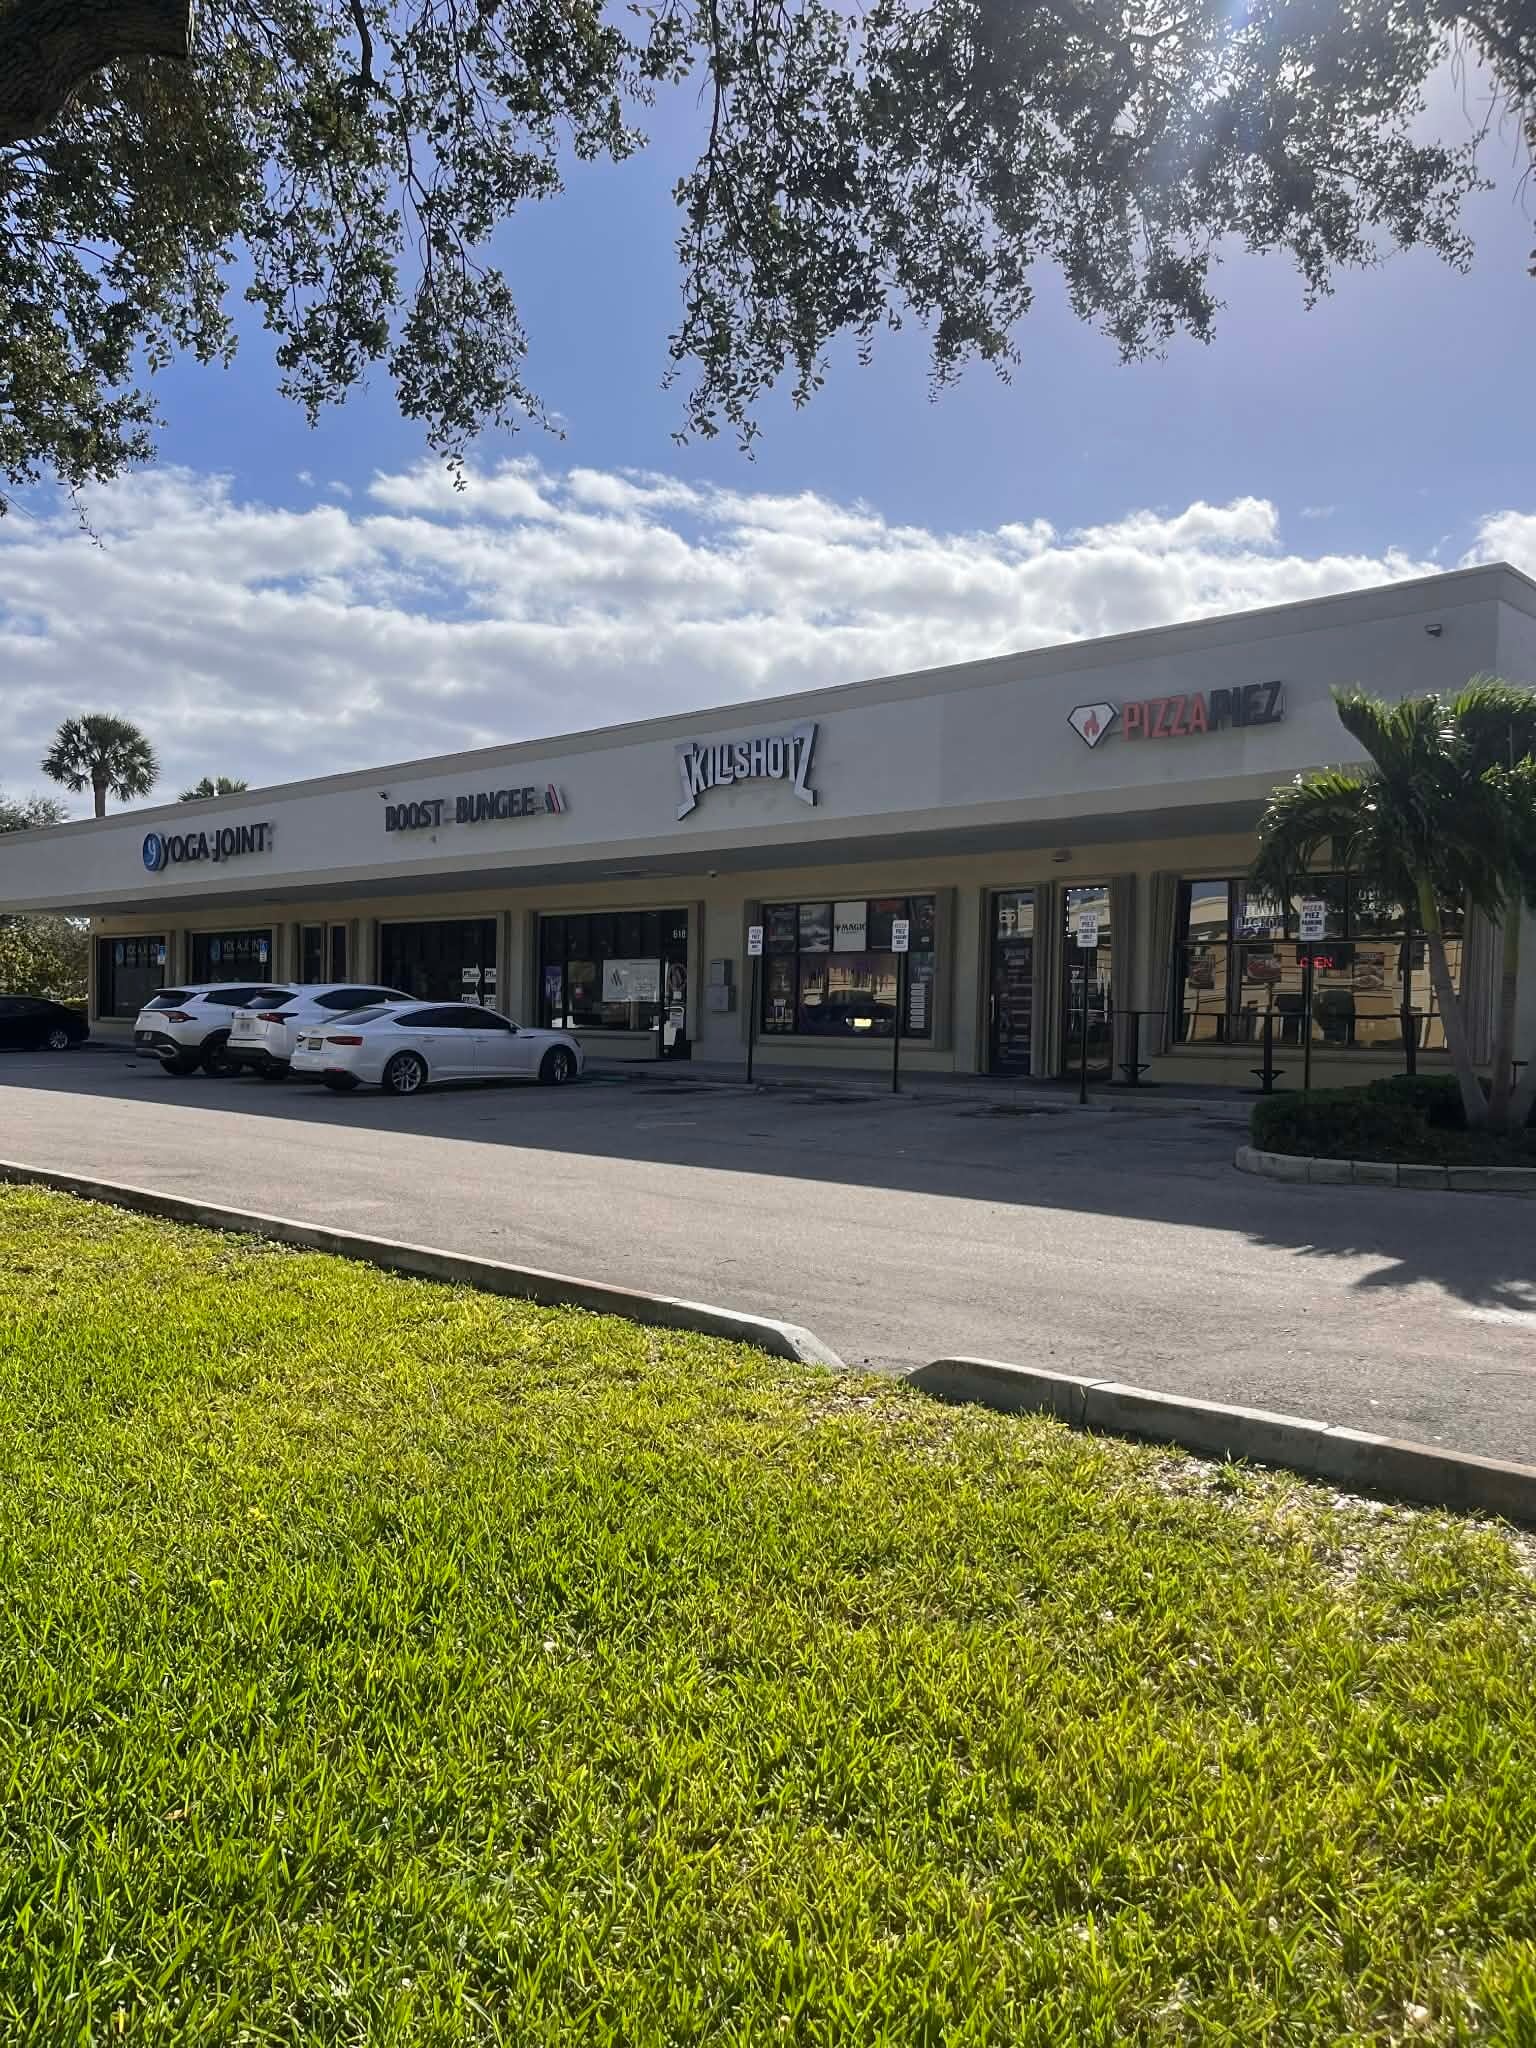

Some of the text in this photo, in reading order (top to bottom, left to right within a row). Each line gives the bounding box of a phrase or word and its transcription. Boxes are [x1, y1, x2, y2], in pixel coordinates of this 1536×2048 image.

[1122, 681, 1282, 740] PIZZA PIEZ
[675, 721, 820, 821] SKILLSHOTZ
[385, 787, 536, 833] BOOST BUNGEE
[161, 822, 270, 864] YOGA JOINT
[1299, 956, 1334, 969] OEN
